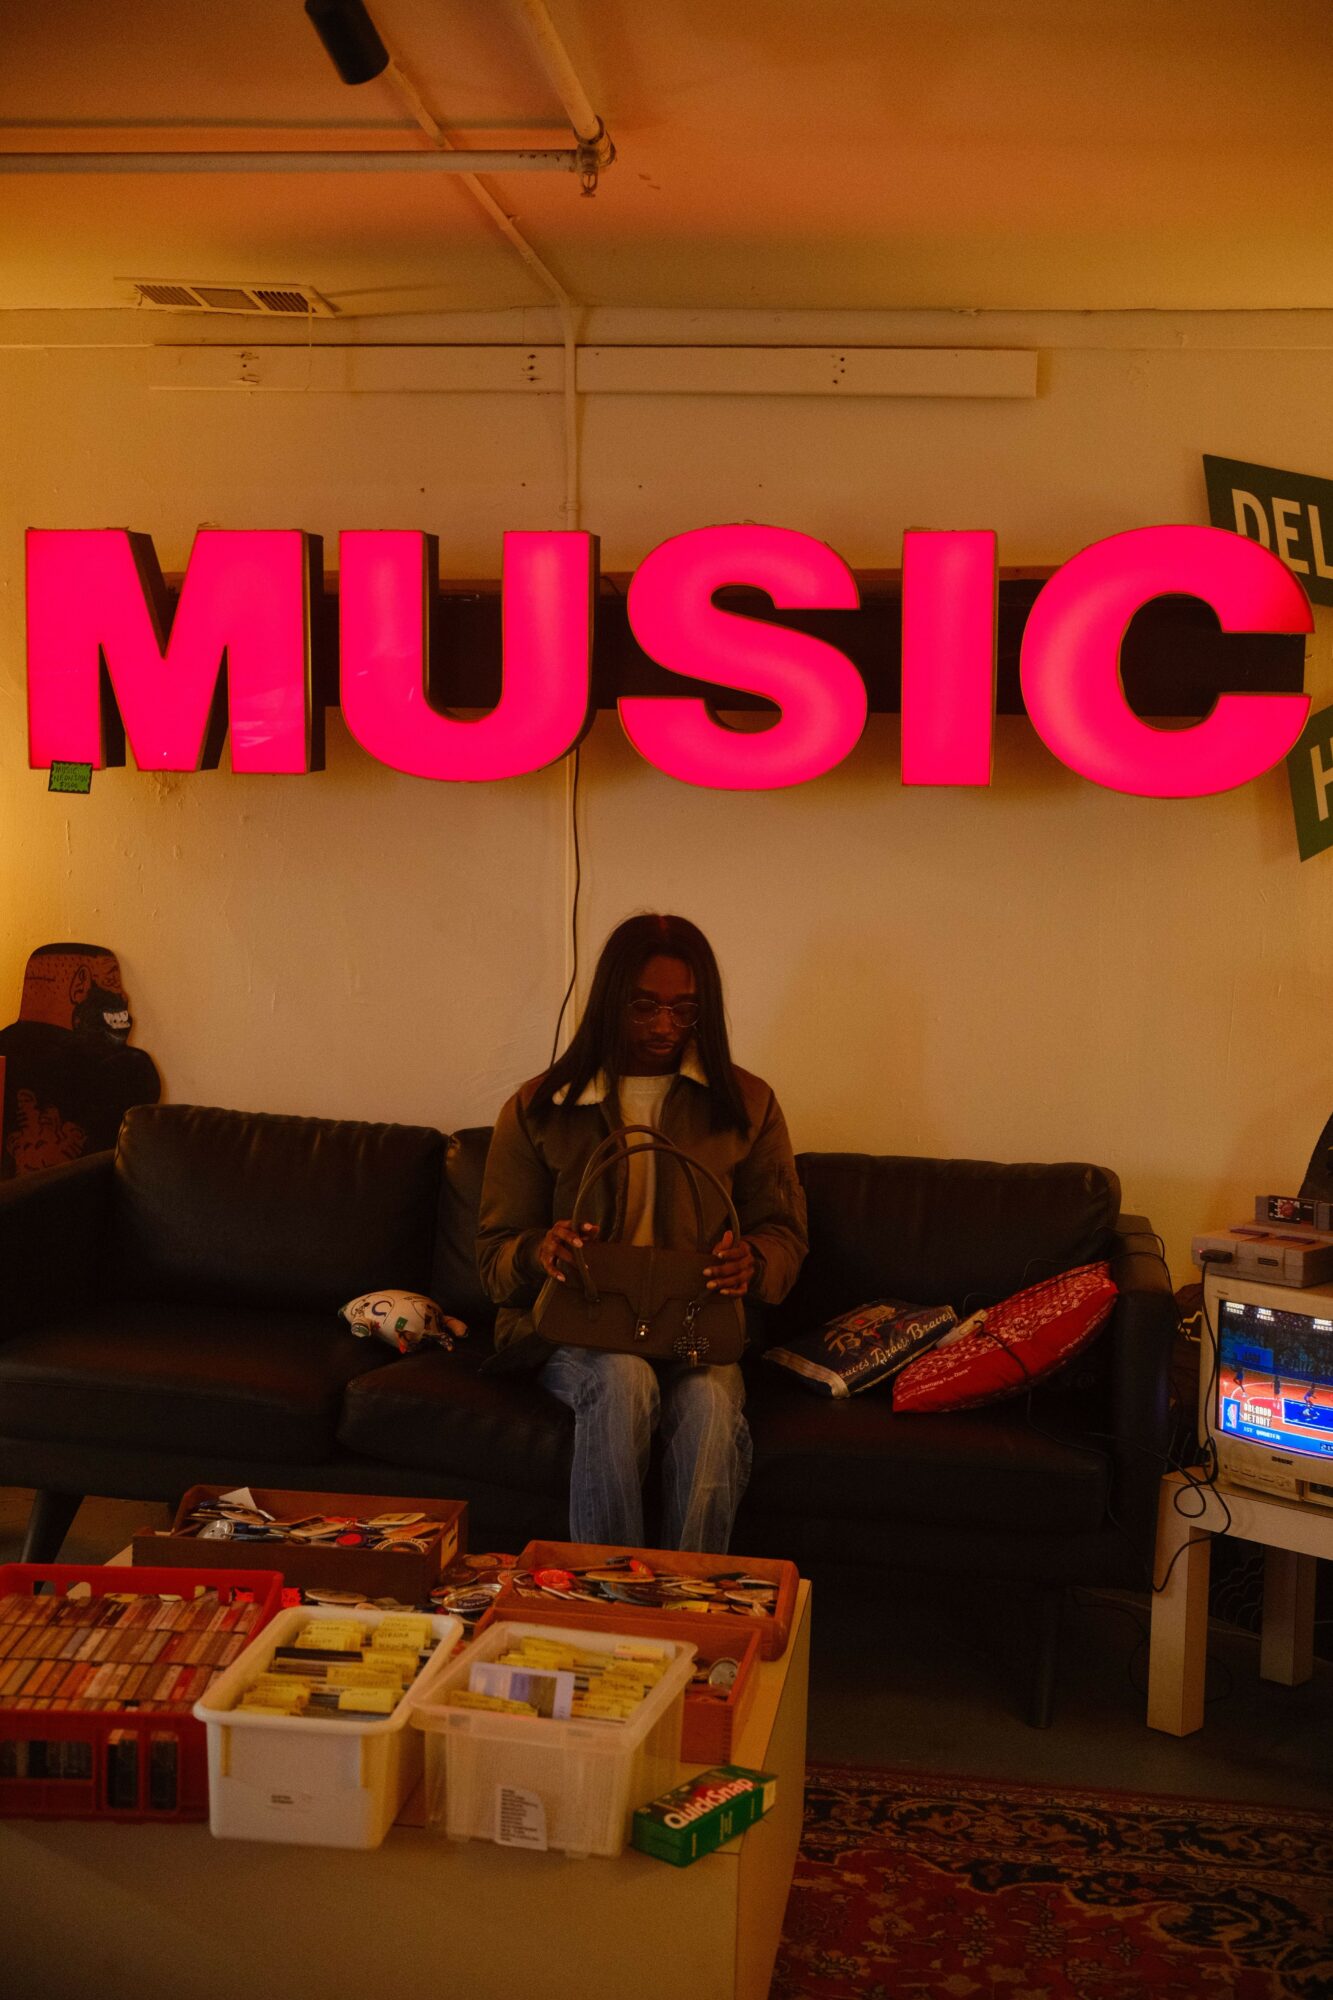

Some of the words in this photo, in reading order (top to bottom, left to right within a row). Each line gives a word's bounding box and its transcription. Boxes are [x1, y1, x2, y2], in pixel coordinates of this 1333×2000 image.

[25, 523, 1315, 799] MUSIC
[1243, 1412, 1271, 1428] DETROIT
[663, 1778, 754, 1830] QuickSnap
